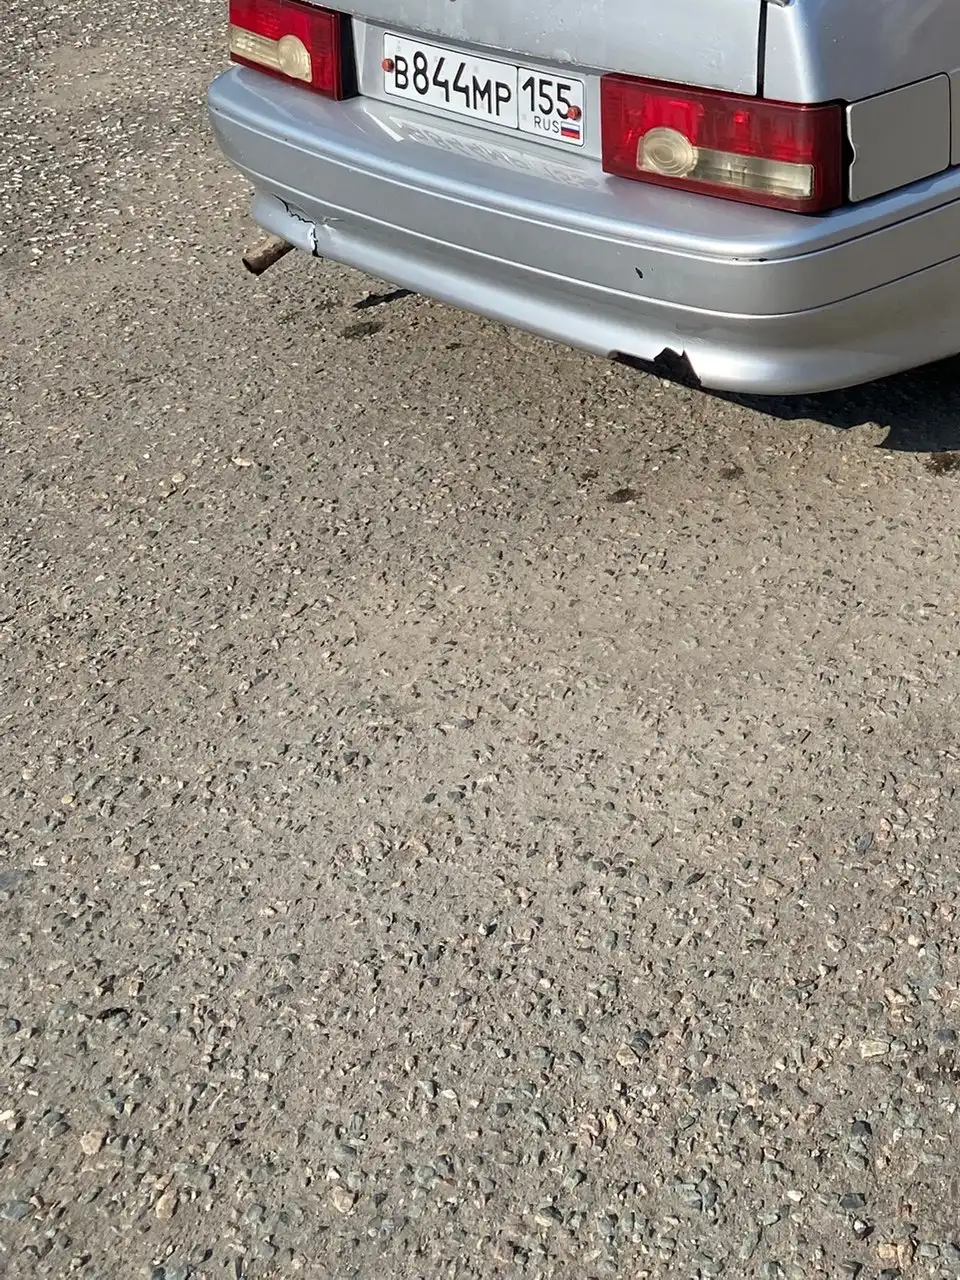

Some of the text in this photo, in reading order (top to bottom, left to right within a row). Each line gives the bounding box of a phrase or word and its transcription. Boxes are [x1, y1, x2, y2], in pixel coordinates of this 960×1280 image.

[394, 51, 572, 120] В844МР 155
[534, 115, 560, 134] RUS
